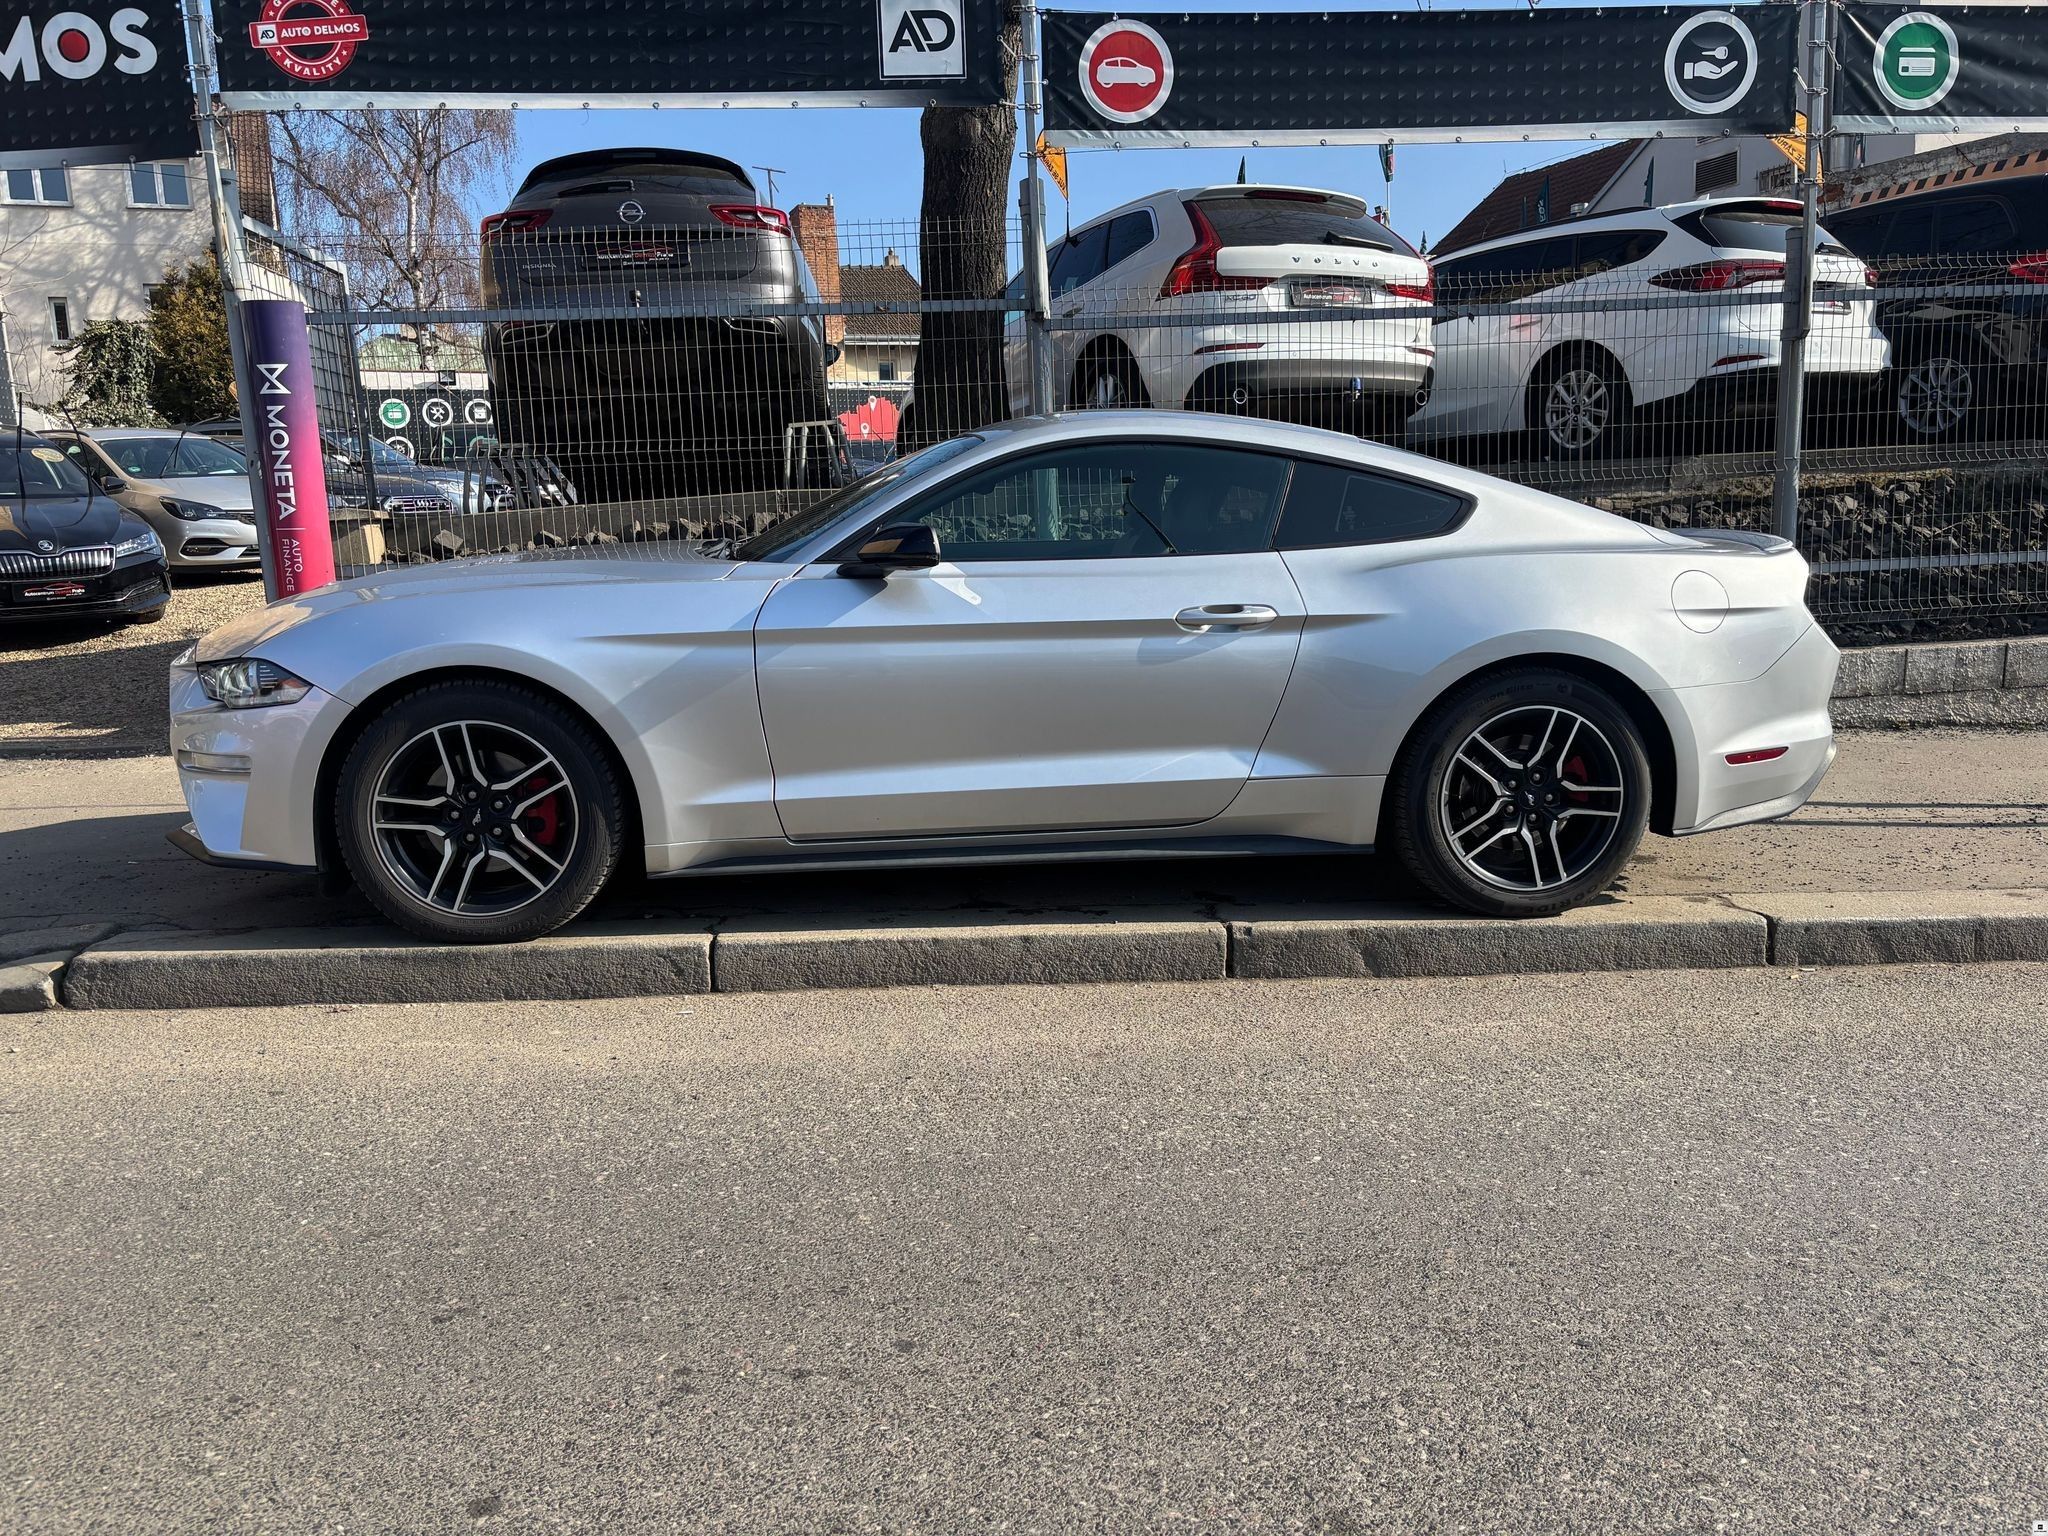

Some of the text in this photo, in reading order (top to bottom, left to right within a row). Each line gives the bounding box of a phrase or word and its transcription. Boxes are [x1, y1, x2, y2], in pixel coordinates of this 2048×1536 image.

[280, 23, 361, 38] AUTO DELMOS
[889, 9, 956, 52] AD
[283, 57, 342, 76] KVALITY
[1291, 256, 1378, 267] VOLVO
[266, 405, 297, 521] MONETA
[281, 538, 295, 593] FINANCE
[290, 538, 303, 574] AUTO
